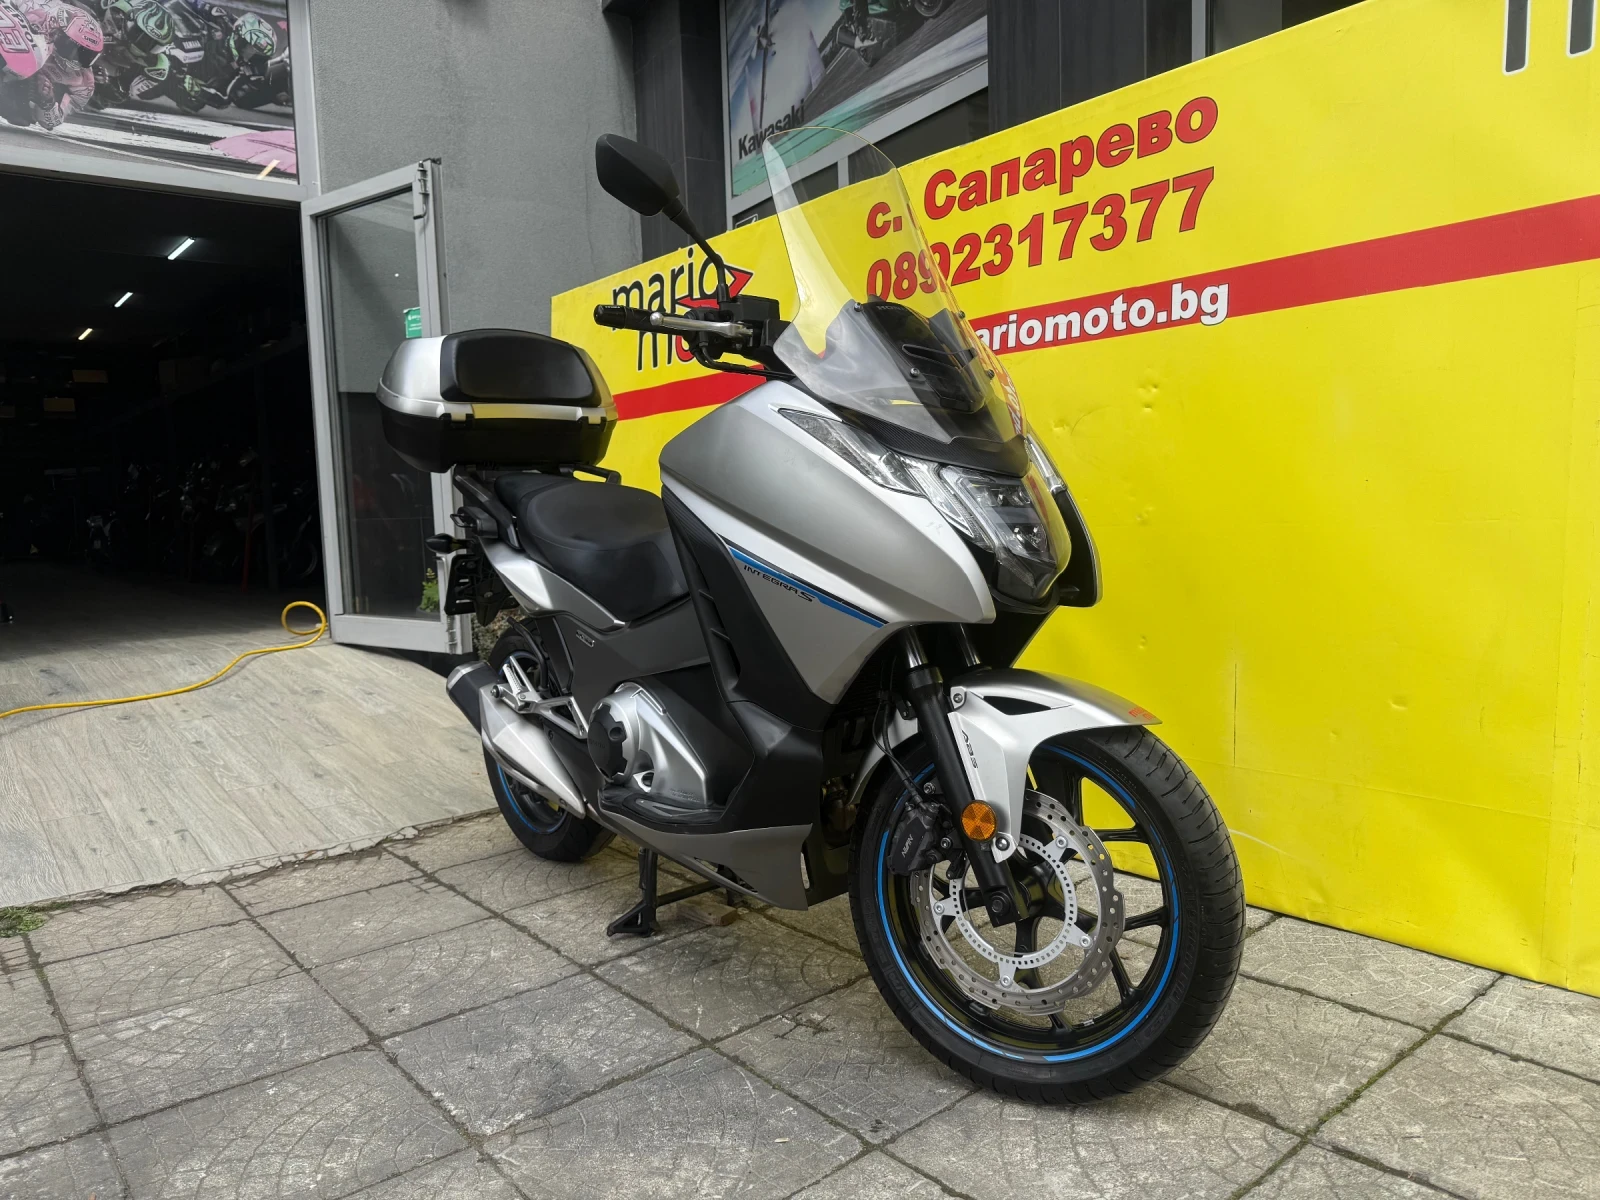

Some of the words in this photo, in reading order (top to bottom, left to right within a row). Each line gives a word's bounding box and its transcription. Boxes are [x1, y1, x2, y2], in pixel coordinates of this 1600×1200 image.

[738, 98, 804, 160] Kawasaki
[923, 96, 1219, 220] Сапарево
[866, 166, 1215, 301] 0892317377
[974, 278, 1230, 351] ariomoto.bg
